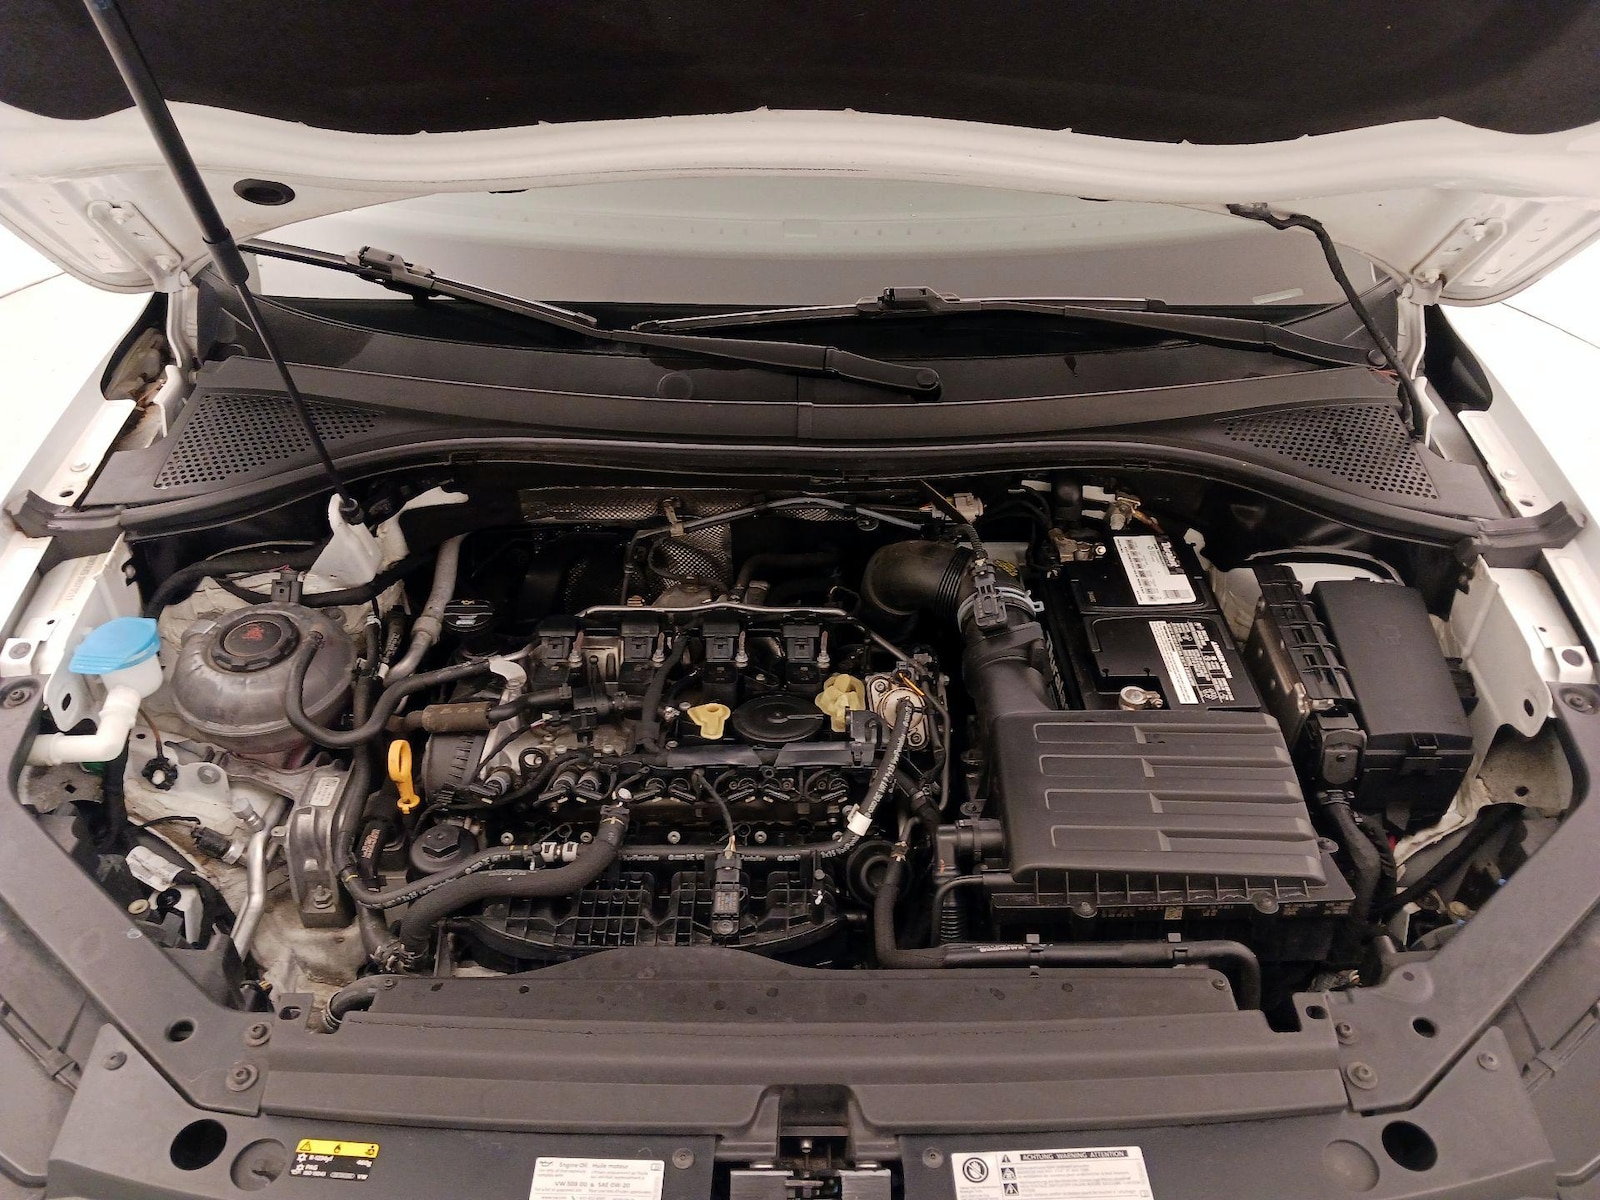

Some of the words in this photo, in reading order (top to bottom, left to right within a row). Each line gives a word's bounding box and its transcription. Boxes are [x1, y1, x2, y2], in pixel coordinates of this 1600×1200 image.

[1022, 1153, 1054, 1161] ACHTUNG
[1056, 1151, 1088, 1160] WARNING
[1089, 1150, 1125, 1158] ATTENTION
